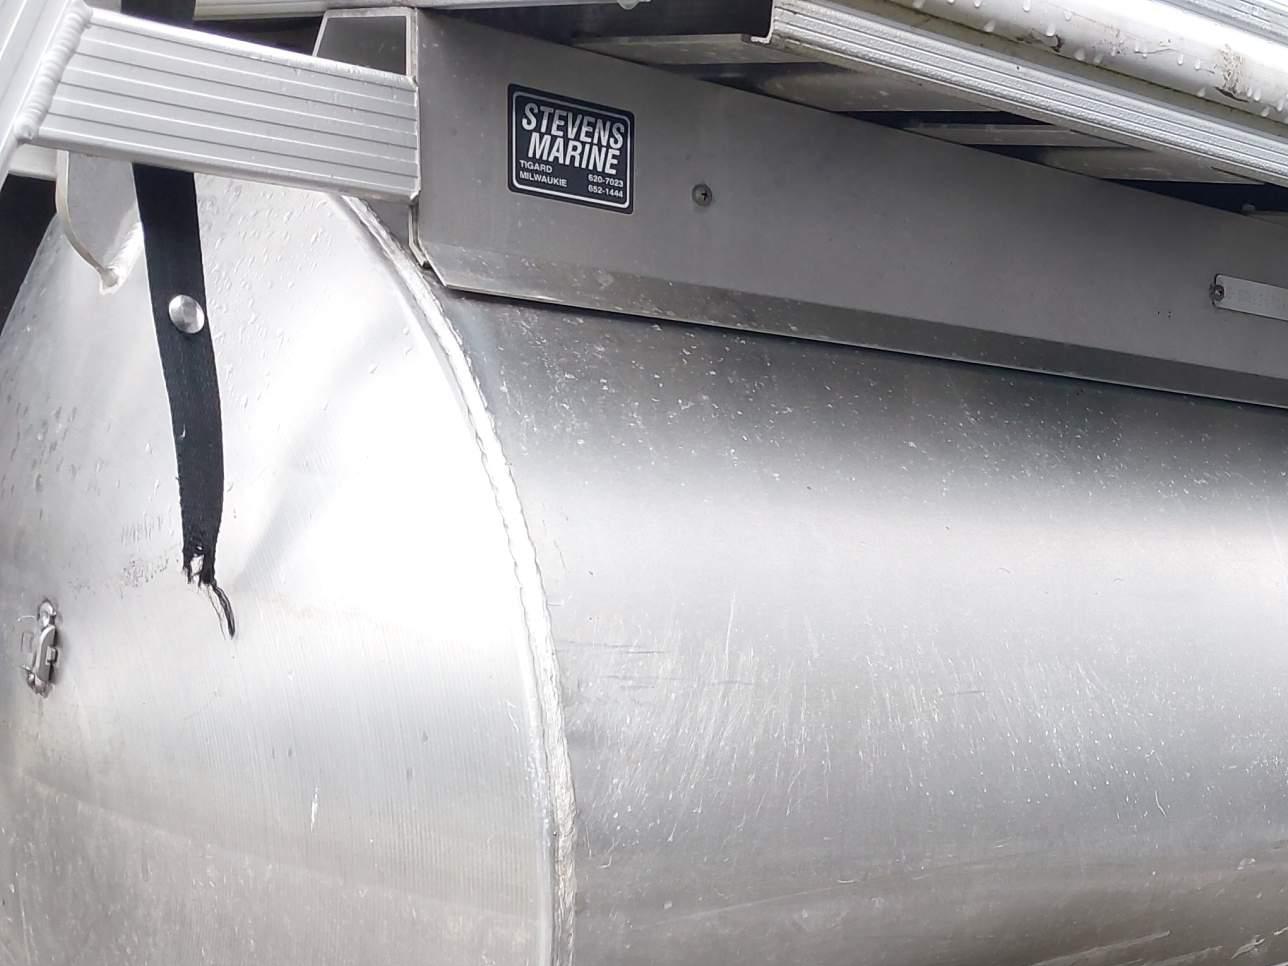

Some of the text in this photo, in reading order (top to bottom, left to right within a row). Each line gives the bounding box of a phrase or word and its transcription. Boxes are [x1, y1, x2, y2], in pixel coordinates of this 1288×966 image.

[521, 102, 625, 149] STEVENS
[528, 131, 620, 175] MARINE
[519, 160, 553, 173] TIGARD
[519, 171, 567, 187] MILWAUKIE
[588, 174, 624, 188] 620-7023
[588, 185, 623, 198] 652-1444
